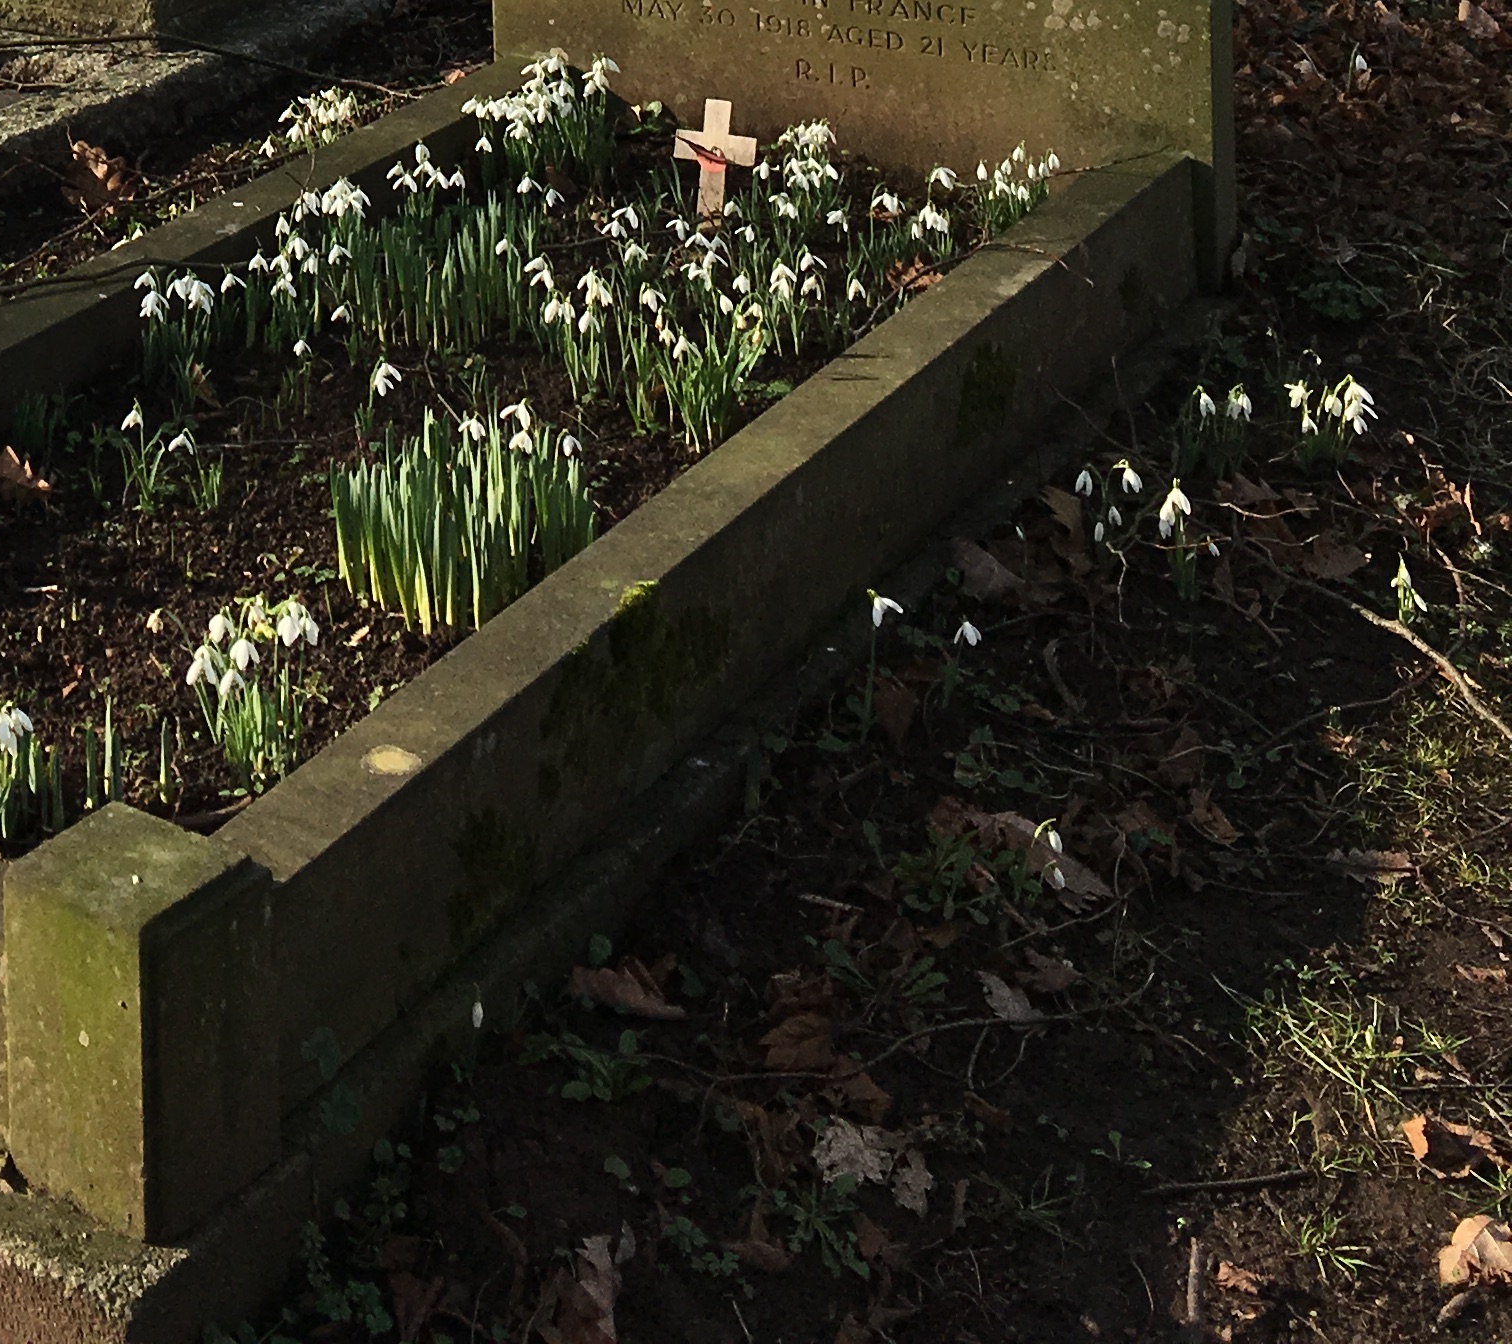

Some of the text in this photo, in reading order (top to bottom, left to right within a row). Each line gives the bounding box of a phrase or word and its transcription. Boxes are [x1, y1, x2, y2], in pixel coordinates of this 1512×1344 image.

[698, 6, 736, 28] 30
[753, 12, 812, 38] 1918
[825, 23, 905, 52] AGED
[919, 35, 945, 59] 21
[963, 42, 1058, 73] YEARS
